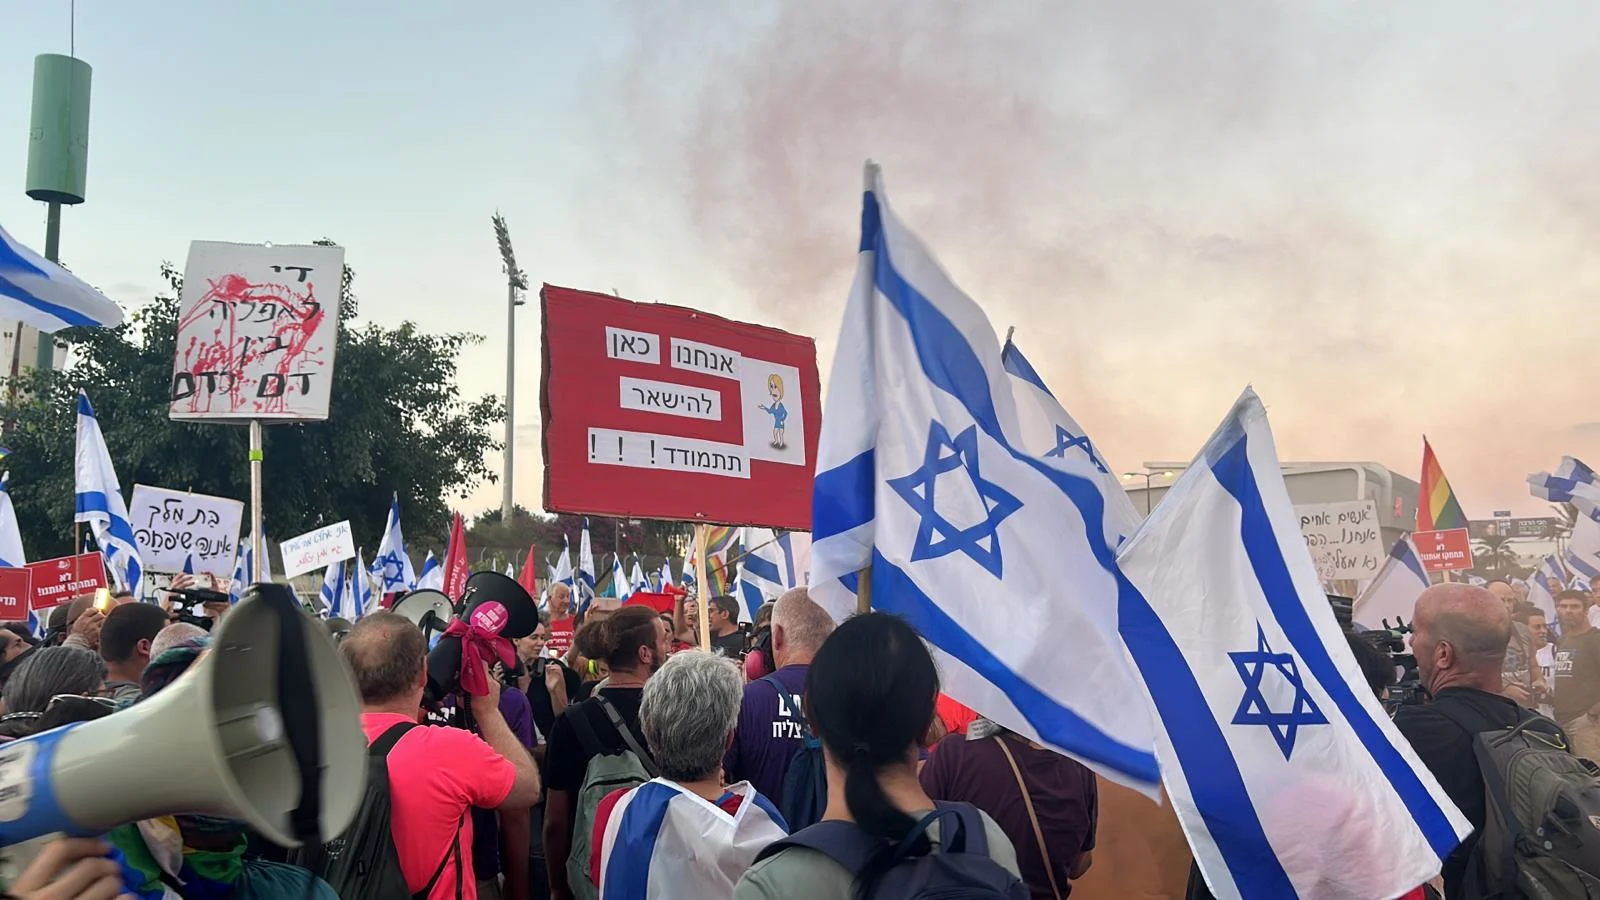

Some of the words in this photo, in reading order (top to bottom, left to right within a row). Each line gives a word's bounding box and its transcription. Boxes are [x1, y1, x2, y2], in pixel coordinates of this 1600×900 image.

[269, 265, 314, 282] די
[209, 290, 321, 323] לאפליה
[240, 336, 289, 370] בין
[612, 333, 651, 358] כאן
[676, 344, 734, 374] אנחנו
[172, 364, 236, 402] לדם
[256, 372, 318, 398] דם
[632, 387, 713, 415] להישאר
[1300, 511, 1331, 530] אחים
[1303, 533, 1327, 549] הפר
[59, 572, 72, 582] לא
[37, 584, 66, 596] אותנו!
[772, 718, 804, 738] צליח
